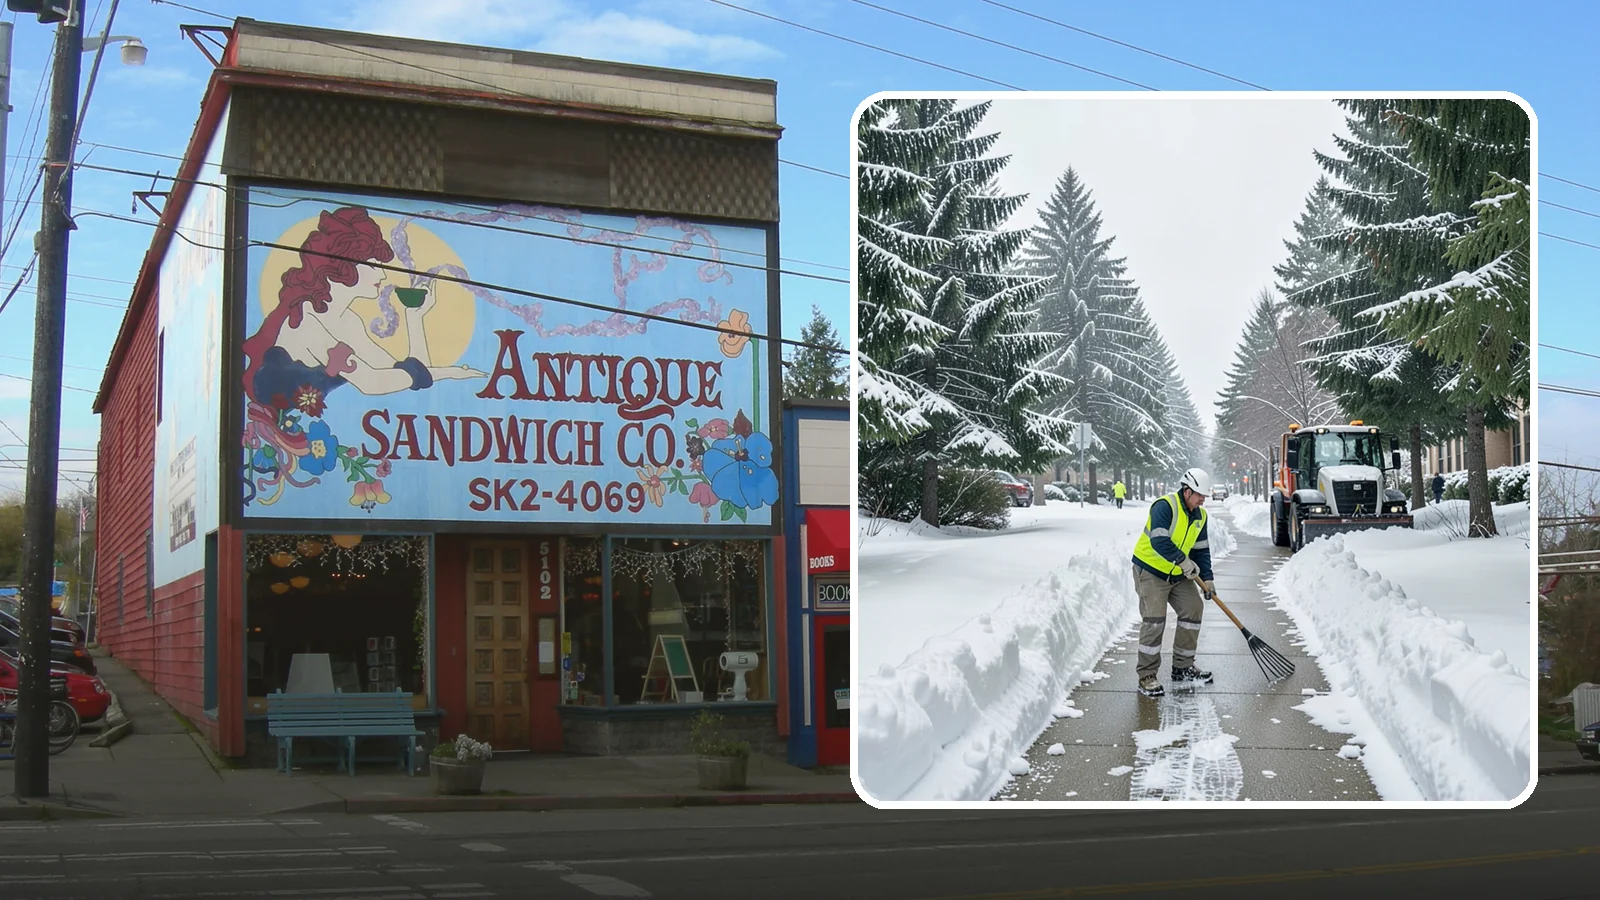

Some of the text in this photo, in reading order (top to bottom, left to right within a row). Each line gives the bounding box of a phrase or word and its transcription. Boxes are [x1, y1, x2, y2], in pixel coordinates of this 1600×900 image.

[476, 329, 724, 420] ANTIQUE
[361, 408, 685, 469] SANDWICH CO.
[468, 477, 646, 513] SK2-4069
[539, 542, 552, 599] 5102
[809, 555, 835, 569] BOOKS
